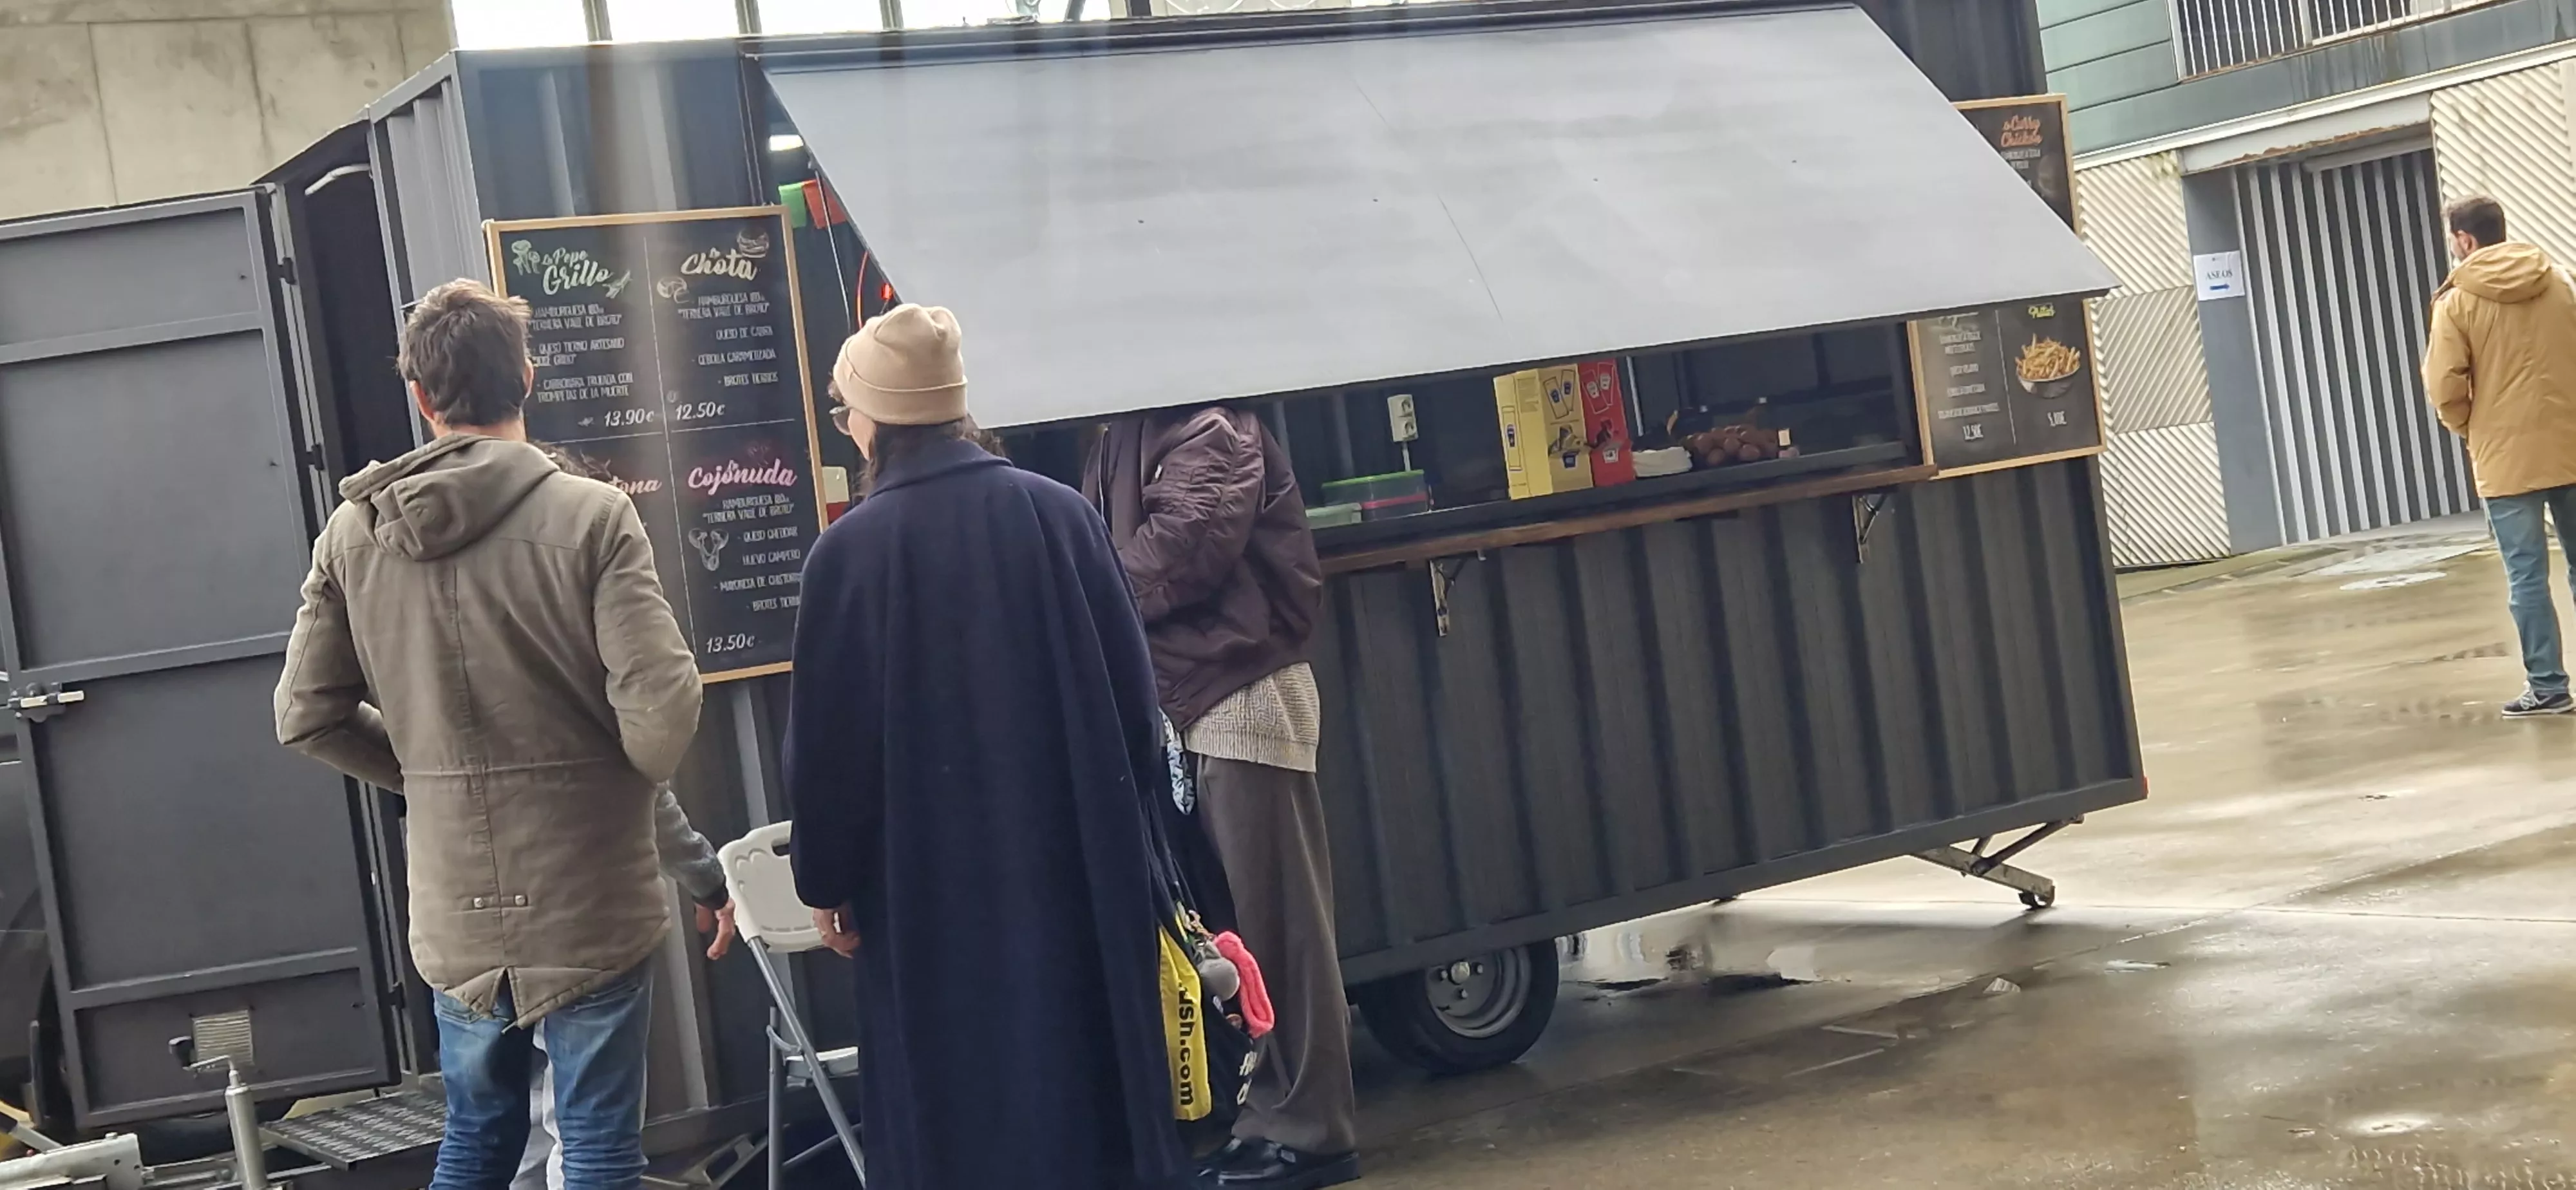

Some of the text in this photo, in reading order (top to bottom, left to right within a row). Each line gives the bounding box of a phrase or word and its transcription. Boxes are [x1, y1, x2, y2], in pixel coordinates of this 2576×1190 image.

[553, 247, 589, 267] Pepe
[681, 248, 758, 281] Chota
[543, 260, 614, 295] Grillo
[2206, 269, 2233, 281] ASEOS
[716, 328, 738, 340] QUESO
[739, 326, 748, 339] DE
[538, 342, 562, 355] QUESO
[590, 337, 625, 351] ARTESANO
[698, 348, 776, 365] CEBOLLA CARAMELIZADA
[617, 372, 634, 383] CON
[724, 373, 749, 386] BROTES
[536, 385, 630, 403] TROMPETAS DE LA MUERTE
[688, 458, 797, 496] Cojonuda
[743, 526, 798, 543] QUESO CHEDDAR
[743, 549, 800, 565] HUEVO CAMPERO
[719, 578, 756, 592] MAYONESA
[757, 576, 766, 588] DE
[752, 598, 777, 612] BROTES
[1179, 985, 1195, 1106] ush.com
